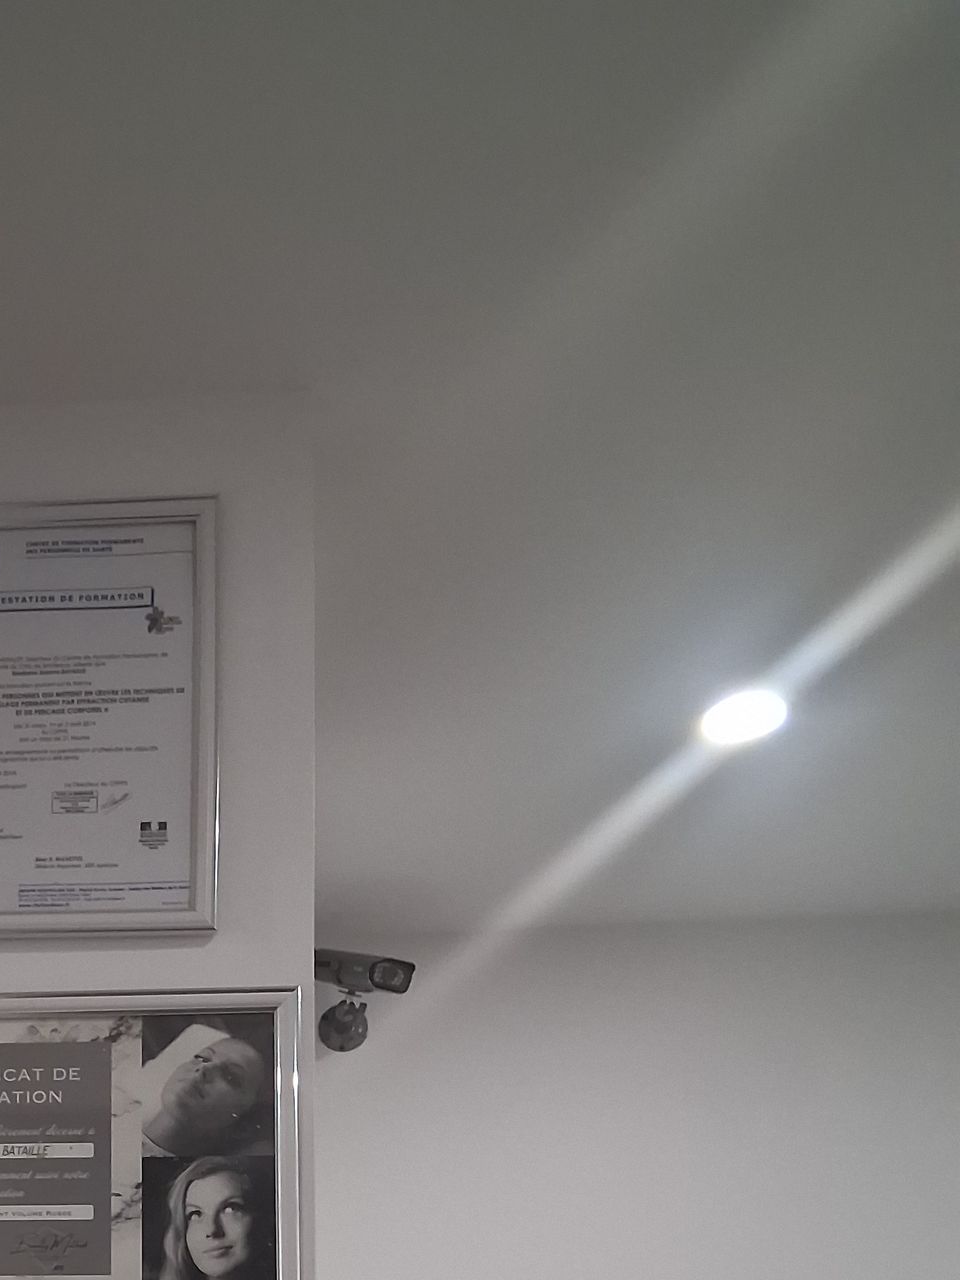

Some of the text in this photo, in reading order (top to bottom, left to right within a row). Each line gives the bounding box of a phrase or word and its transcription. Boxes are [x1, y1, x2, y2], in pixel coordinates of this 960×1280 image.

[60, 594, 74, 603] DE
[78, 591, 145, 602] FORMATION
[53, 1067, 81, 1081] DE
[2, 1144, 50, 1157] BATAILLE
